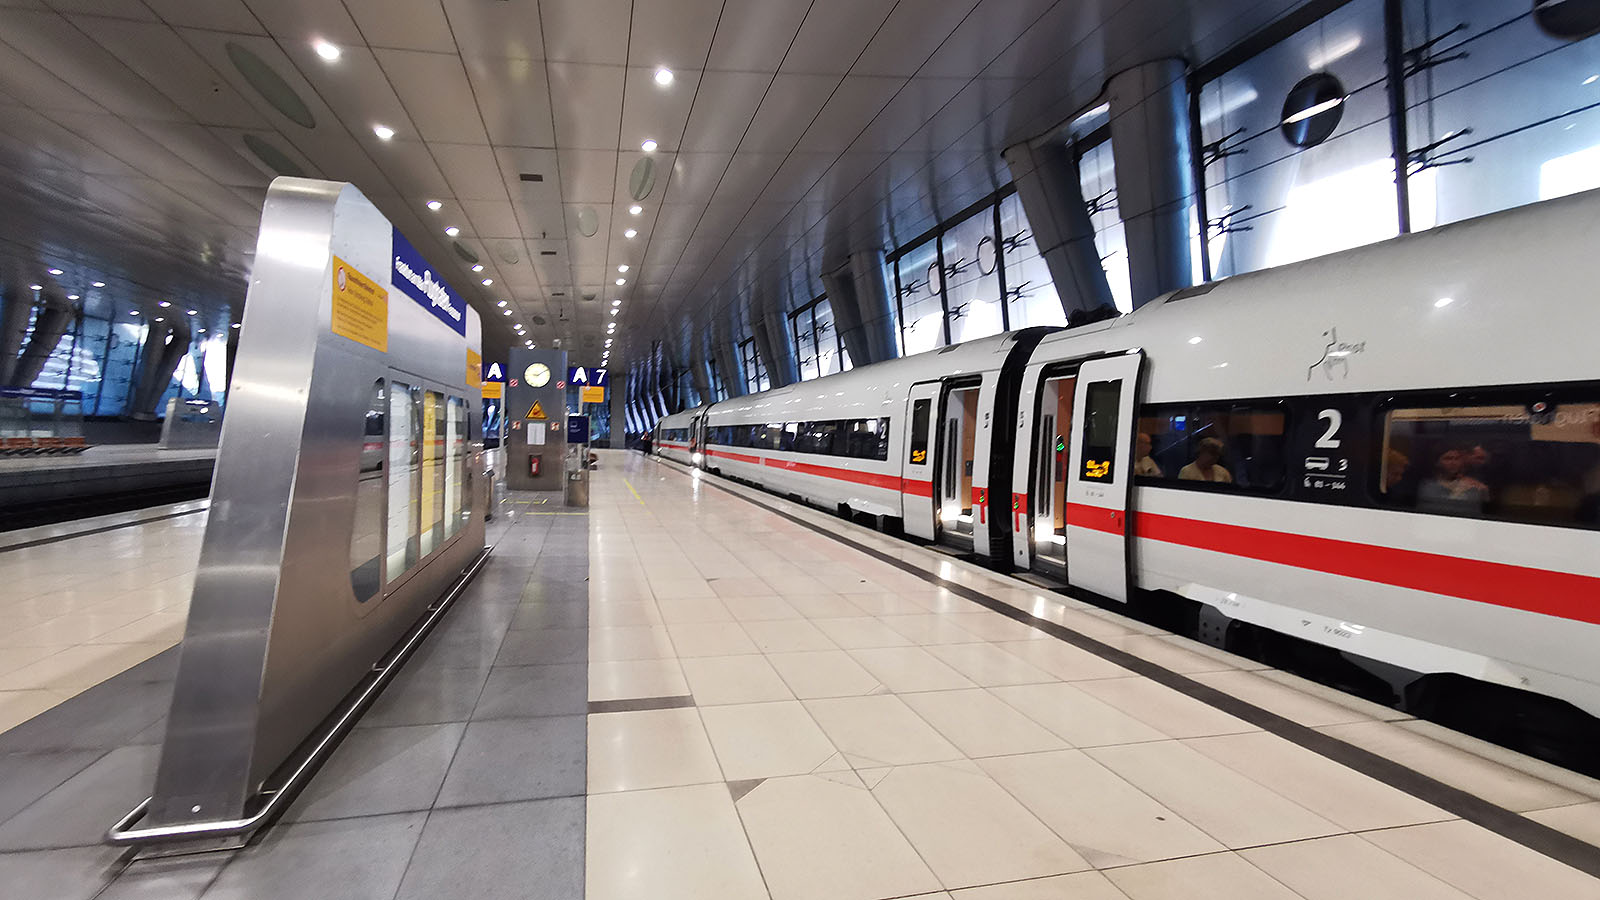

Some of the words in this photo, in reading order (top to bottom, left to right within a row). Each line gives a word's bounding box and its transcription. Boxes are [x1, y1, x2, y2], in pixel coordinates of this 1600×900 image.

[487, 362, 502, 379] A
[572, 366, 588, 383] A
[595, 369, 607, 385] 7
[880, 422, 887, 440] 2
[1314, 408, 1342, 448] 2
[1338, 458, 1348, 471] 3
